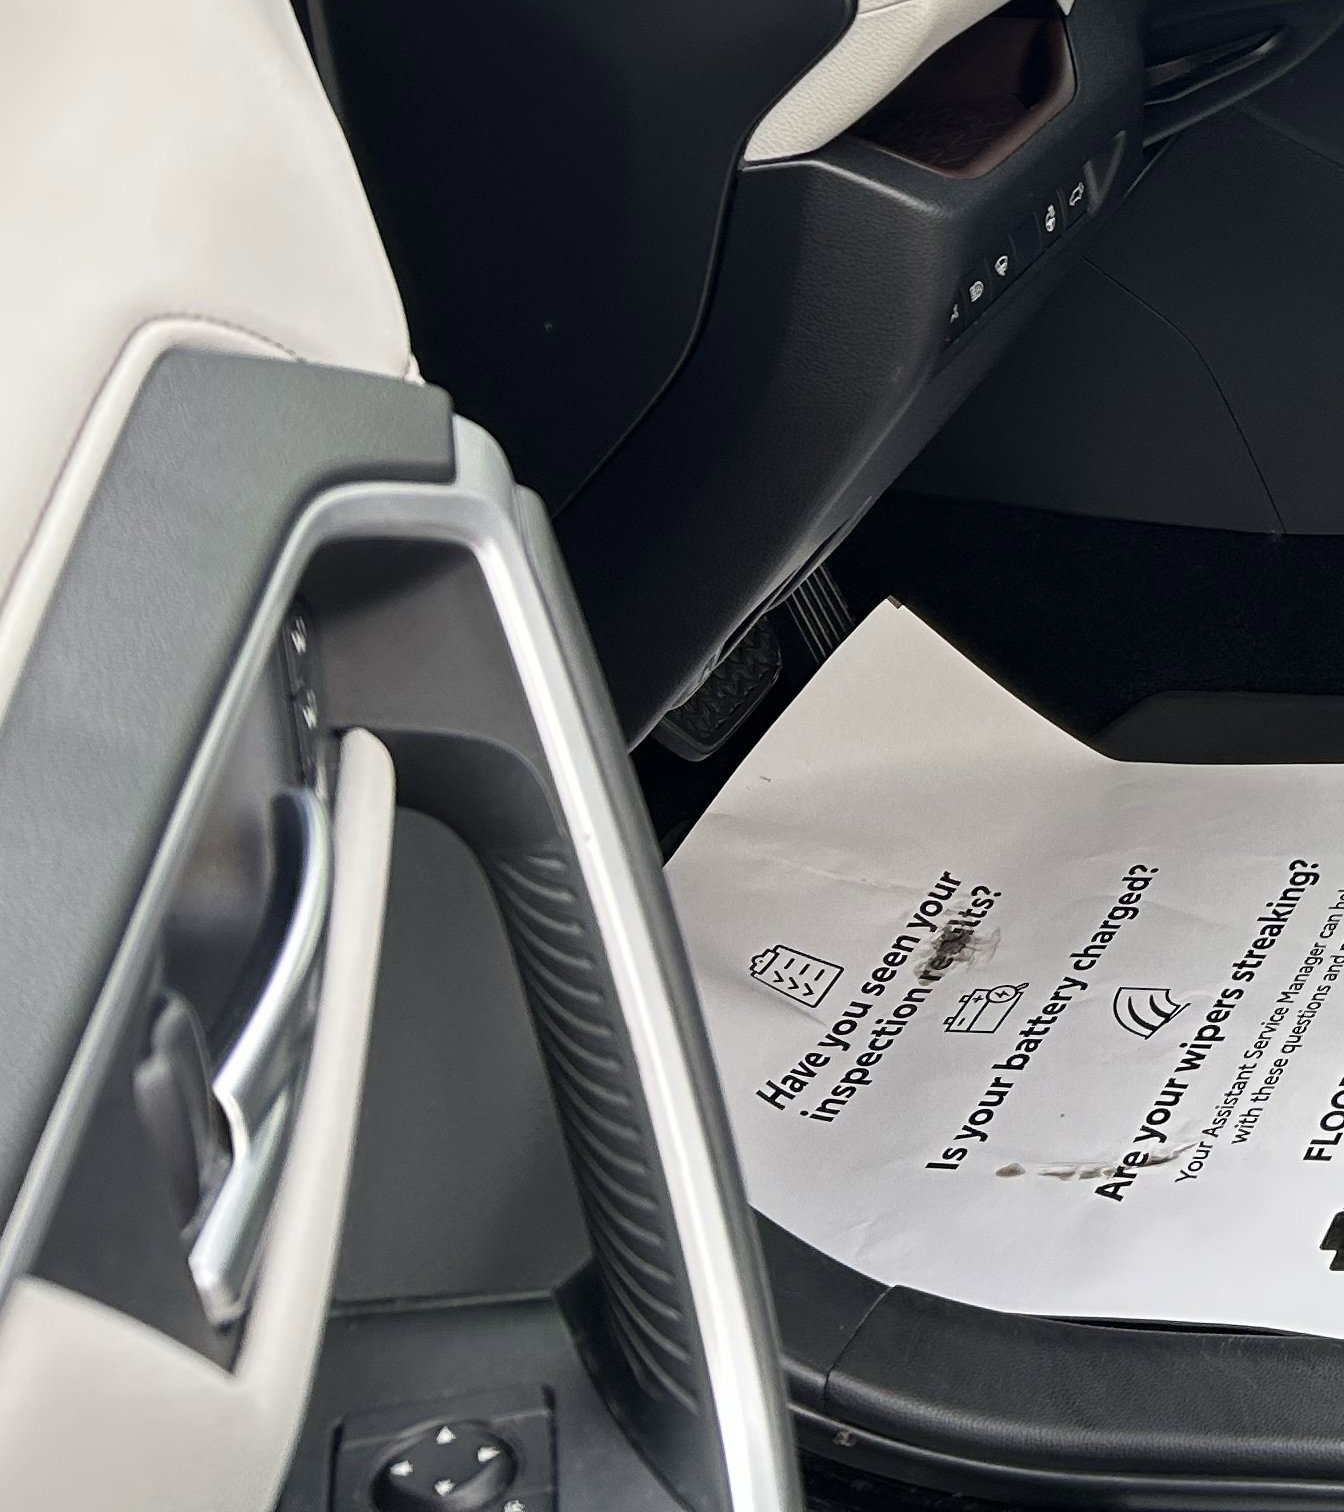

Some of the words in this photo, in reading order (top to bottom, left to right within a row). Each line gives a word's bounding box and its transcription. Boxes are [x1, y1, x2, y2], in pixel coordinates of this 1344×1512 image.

[755, 1052, 831, 1111] Have
[816, 1000, 874, 1051] you
[860, 934, 922, 997] seen
[905, 870, 962, 933] your
[800, 987, 933, 1123] inspection
[924, 1147, 968, 1170] Is
[952, 1076, 1014, 1142] your
[990, 976, 1088, 1071] battery
[1069, 864, 1159, 971] charged?
[1094, 1150, 1150, 1202] Are
[1132, 1077, 1189, 1144] your
[1173, 988, 1245, 1073] wipers
[1231, 858, 1320, 983] streaking?
[1174, 1140, 1213, 1183] Your
[1201, 1062, 1258, 1138] Assistant
[1243, 1006, 1290, 1059] Service
[1275, 941, 1327, 1004] Manager
[1318, 913, 1344, 939] can
[1230, 1107, 1264, 1145] with
[1249, 1058, 1289, 1103] these
[1280, 984, 1332, 1054] questions
